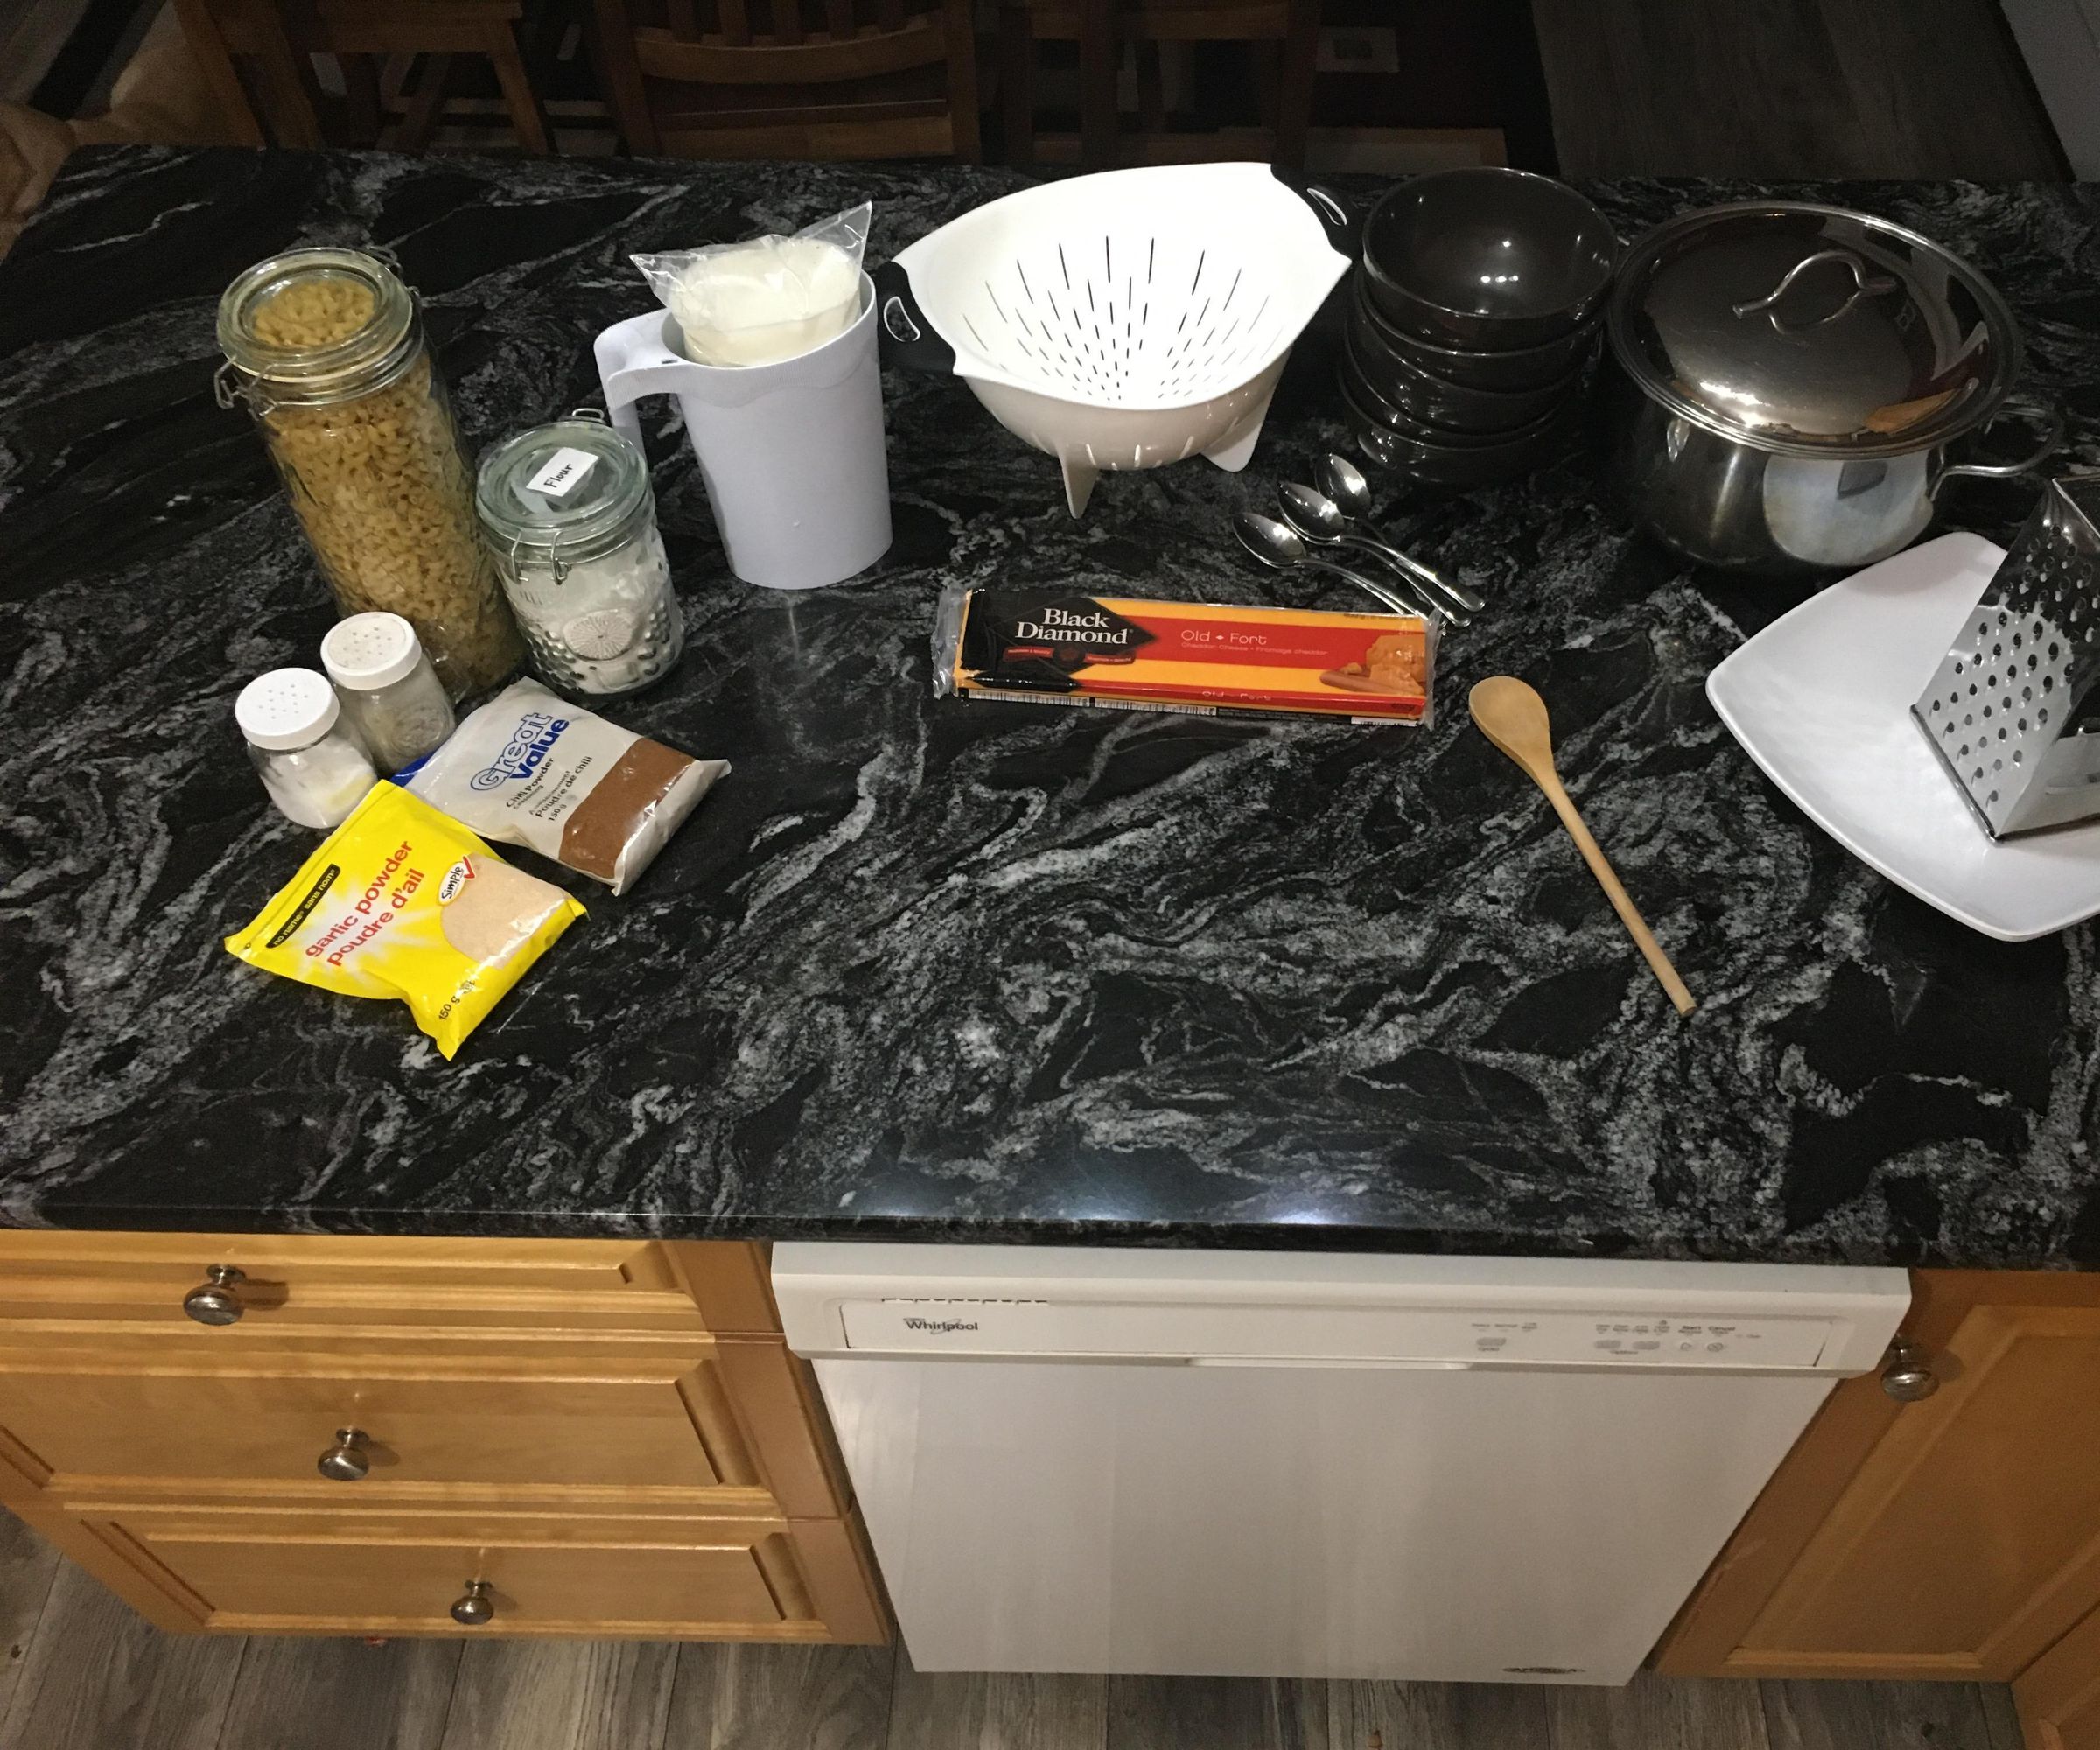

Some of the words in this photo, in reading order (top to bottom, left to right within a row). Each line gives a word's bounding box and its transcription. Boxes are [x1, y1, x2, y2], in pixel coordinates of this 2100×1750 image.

[543, 464, 572, 488] Flour
[1014, 620, 1128, 645] Diamond
[1042, 607, 1110, 628] Black
[1180, 629, 1212, 642] Old
[1229, 632, 1267, 645] Fort
[470, 711, 553, 791] Great
[508, 719, 570, 779] Value
[505, 789, 528, 808] Chili
[524, 757, 554, 792] Powder
[535, 788, 568, 818] Poudre
[564, 774, 578, 788] de
[574, 755, 593, 774] chili
[548, 808, 561, 822] 150
[305, 915, 359, 957] garlic
[354, 840, 413, 915] powder
[441, 866, 463, 900] Simple
[273, 934, 284, 946] no
[283, 913, 304, 936] name
[304, 890, 321, 910] sans
[318, 872, 335, 891] nom
[326, 911, 394, 967] poudre
[391, 868, 425, 909] d'ail
[438, 1004, 452, 1020] 150
[451, 995, 461, 1004] g
[903, 1319, 979, 1333] Whirlpool
